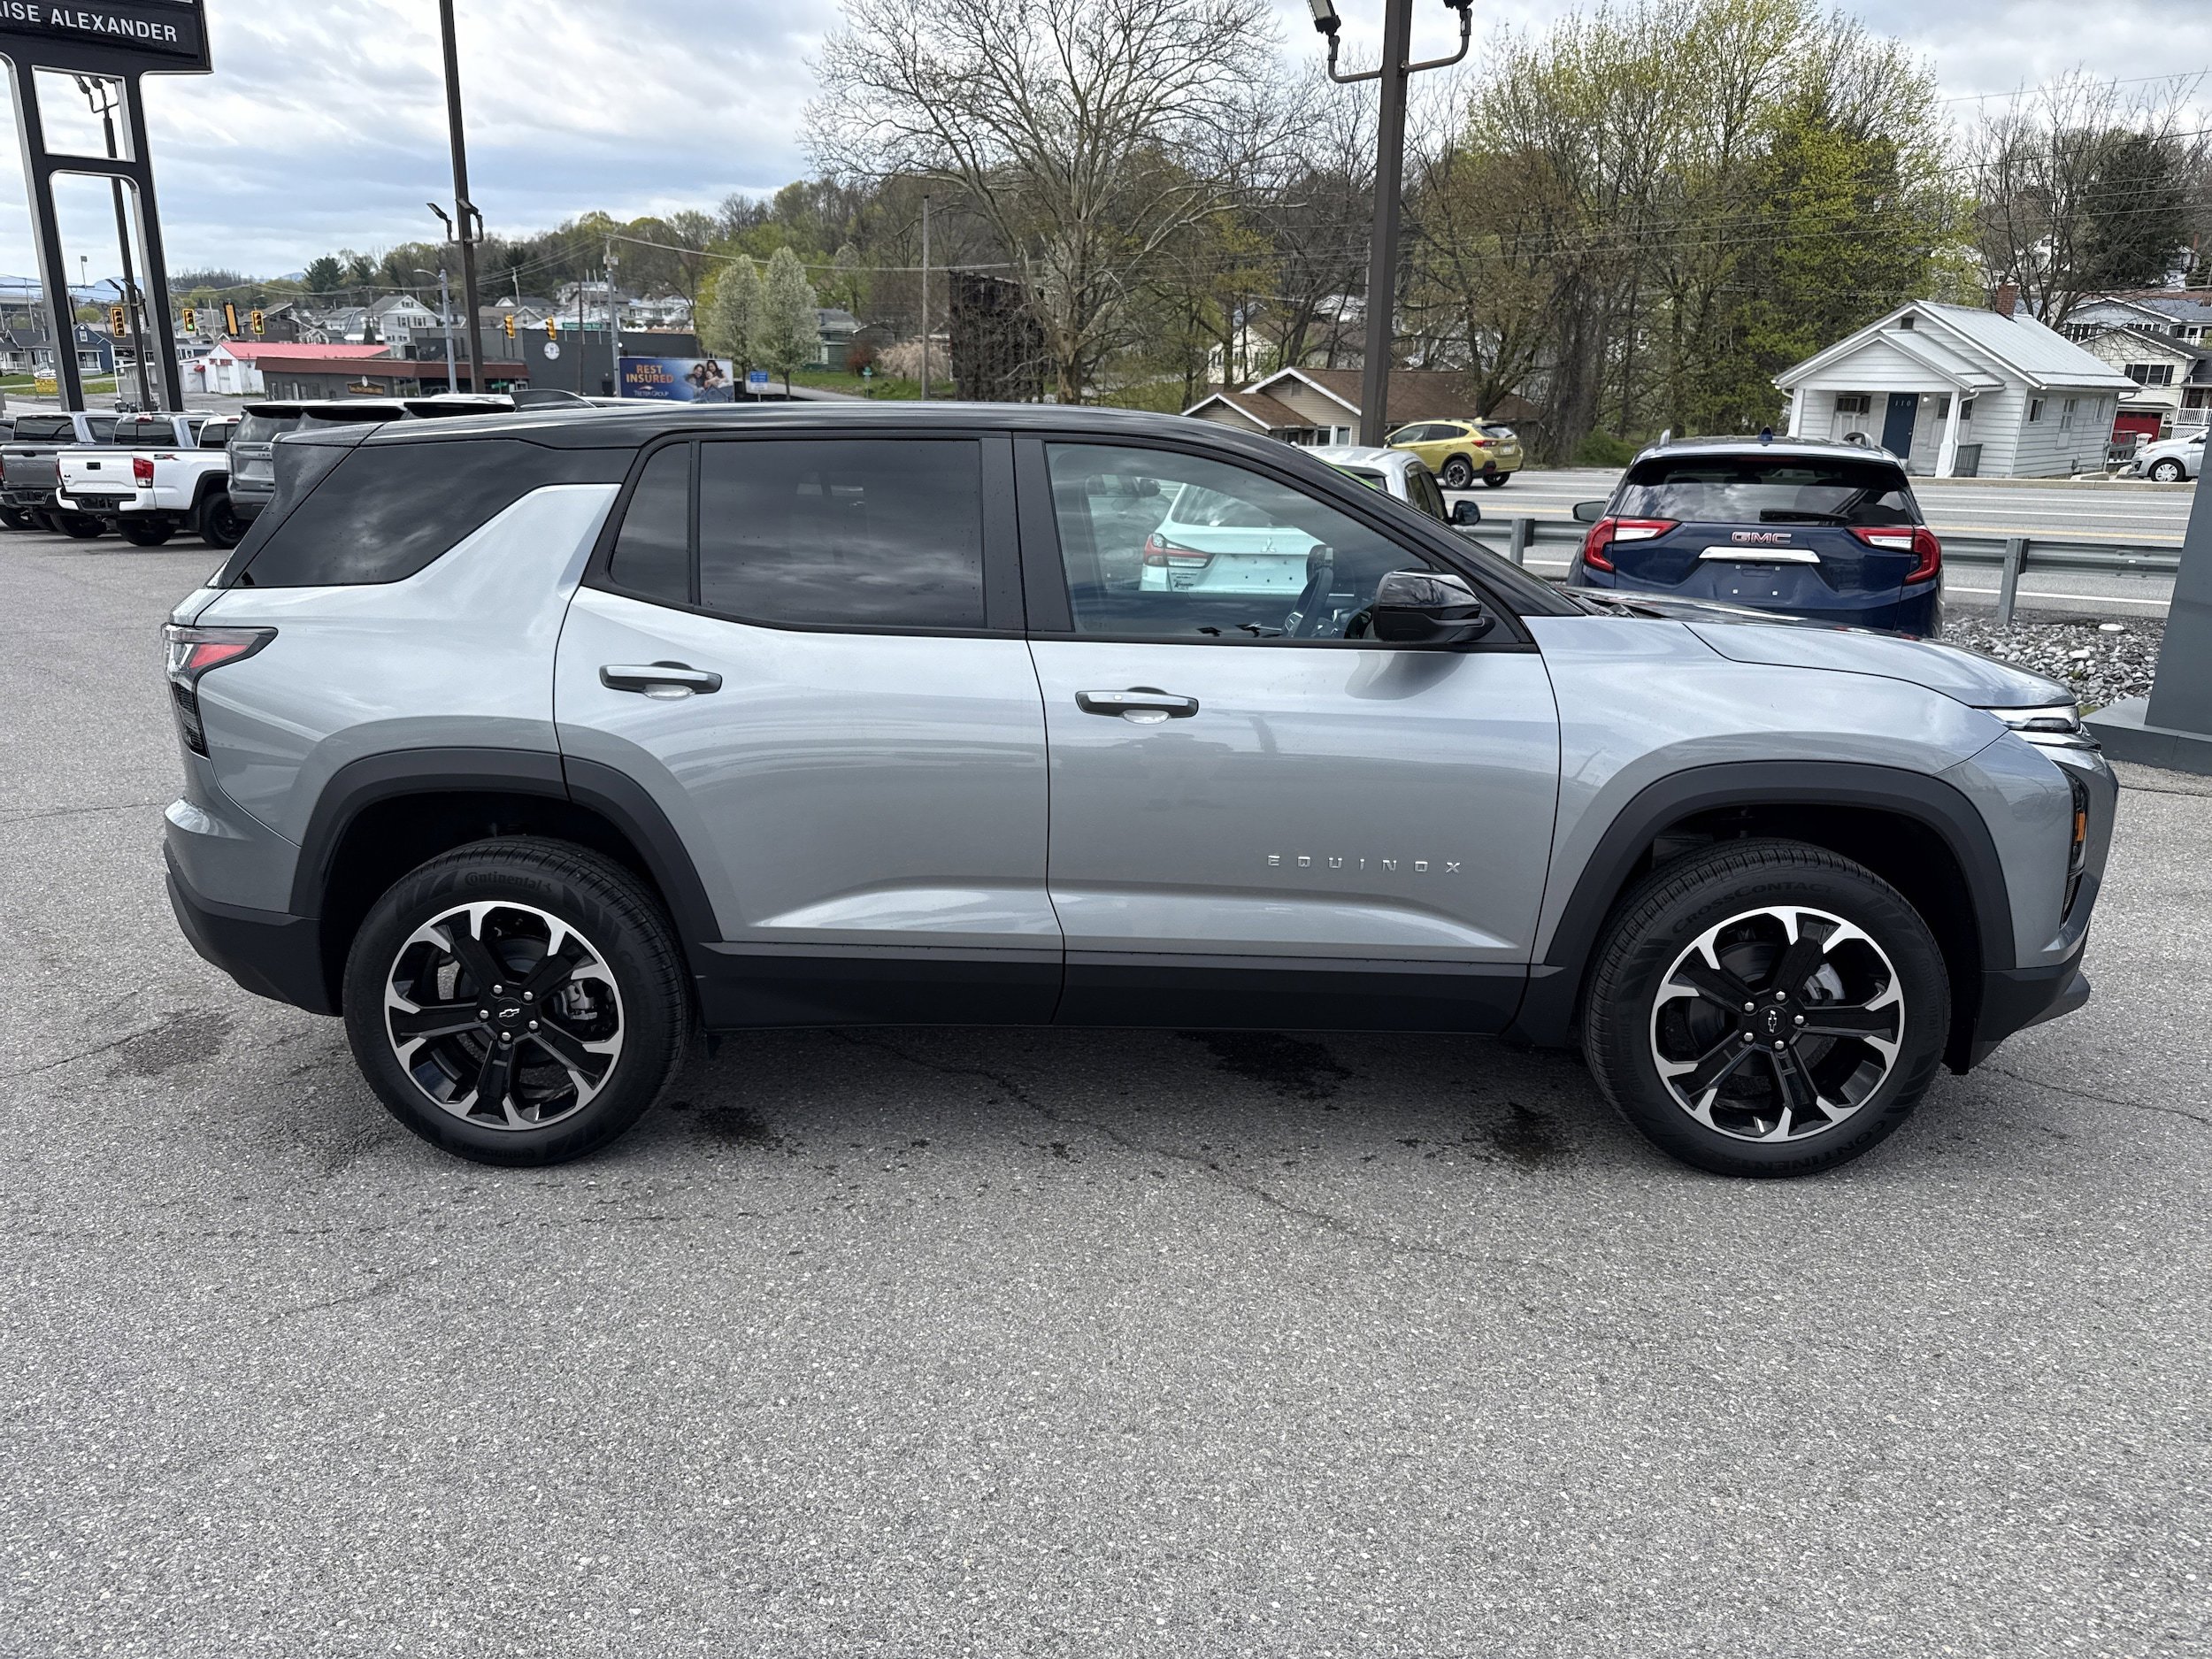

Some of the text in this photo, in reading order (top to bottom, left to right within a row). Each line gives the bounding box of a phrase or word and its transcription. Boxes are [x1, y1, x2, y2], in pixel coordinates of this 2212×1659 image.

[50, 8, 177, 42] ALEXANDER
[635, 364, 663, 374] REST
[626, 373, 674, 384] INSURED
[1731, 531, 1793, 545] GMC
[1266, 854, 1461, 874] EQUINOX
[464, 870, 543, 892] Continental
